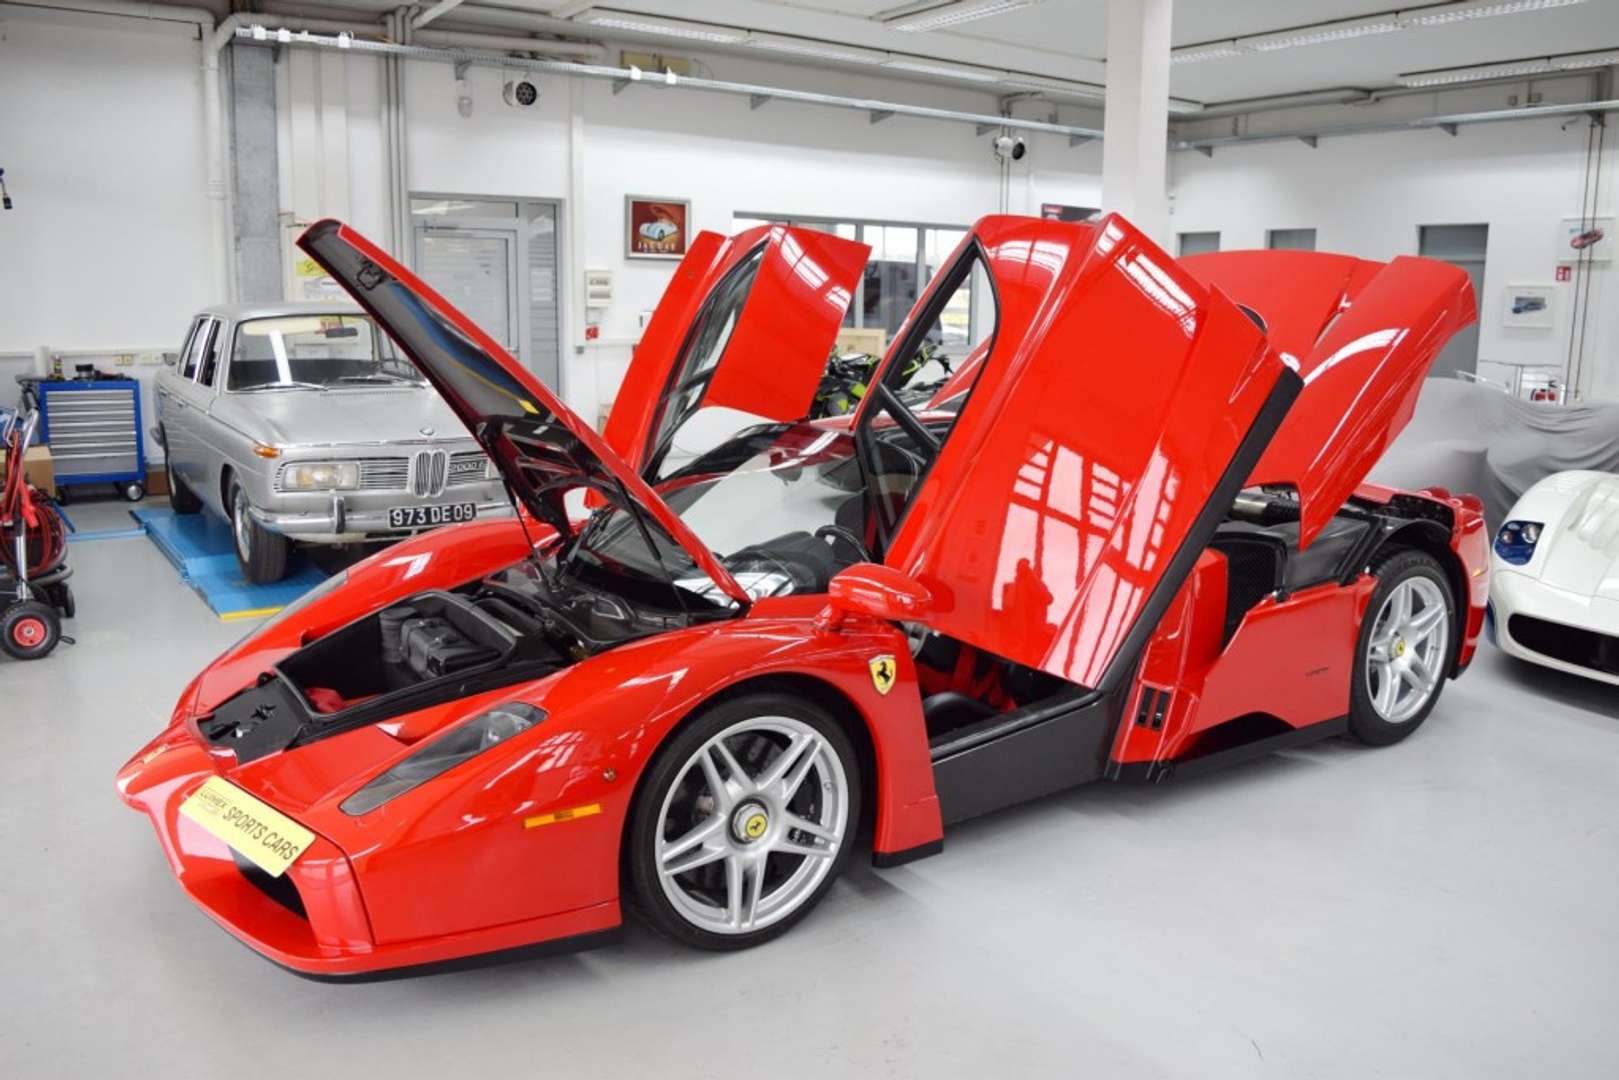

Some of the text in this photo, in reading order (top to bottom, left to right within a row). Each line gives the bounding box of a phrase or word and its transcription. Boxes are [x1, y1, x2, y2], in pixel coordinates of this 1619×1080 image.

[393, 504, 473, 525] 973 DE 09
[222, 806, 299, 861] SPORTS CARS
